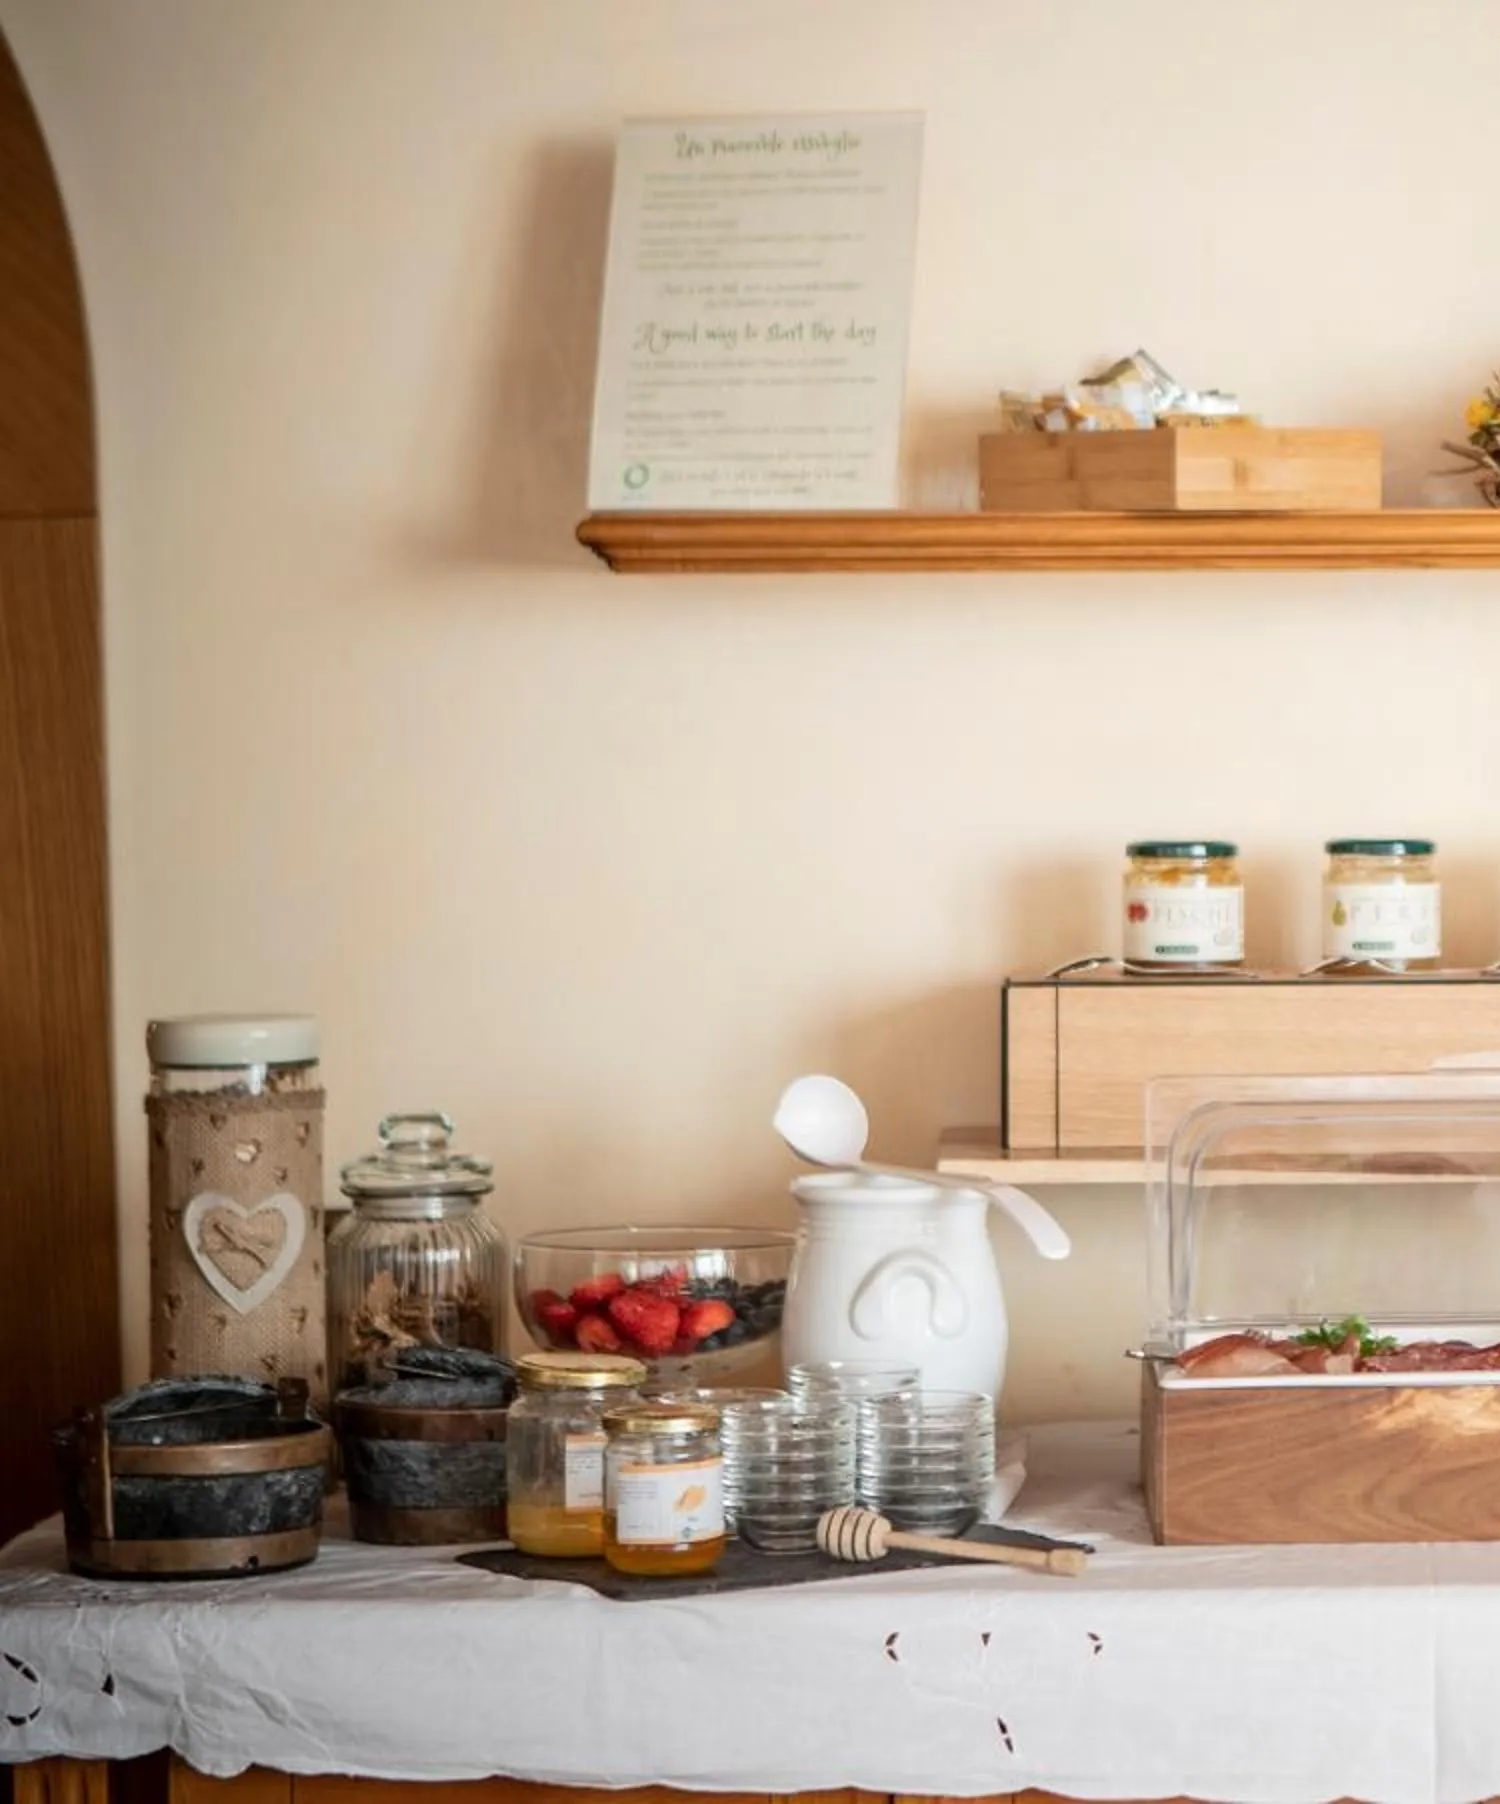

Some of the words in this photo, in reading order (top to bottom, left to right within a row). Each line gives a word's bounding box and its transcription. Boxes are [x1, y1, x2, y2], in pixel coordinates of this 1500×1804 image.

[660, 321, 699, 354] good
[704, 324, 738, 350] way
[745, 321, 760, 342] to
[765, 320, 803, 343] start
[811, 320, 836, 343] the
[844, 317, 878, 347] day
